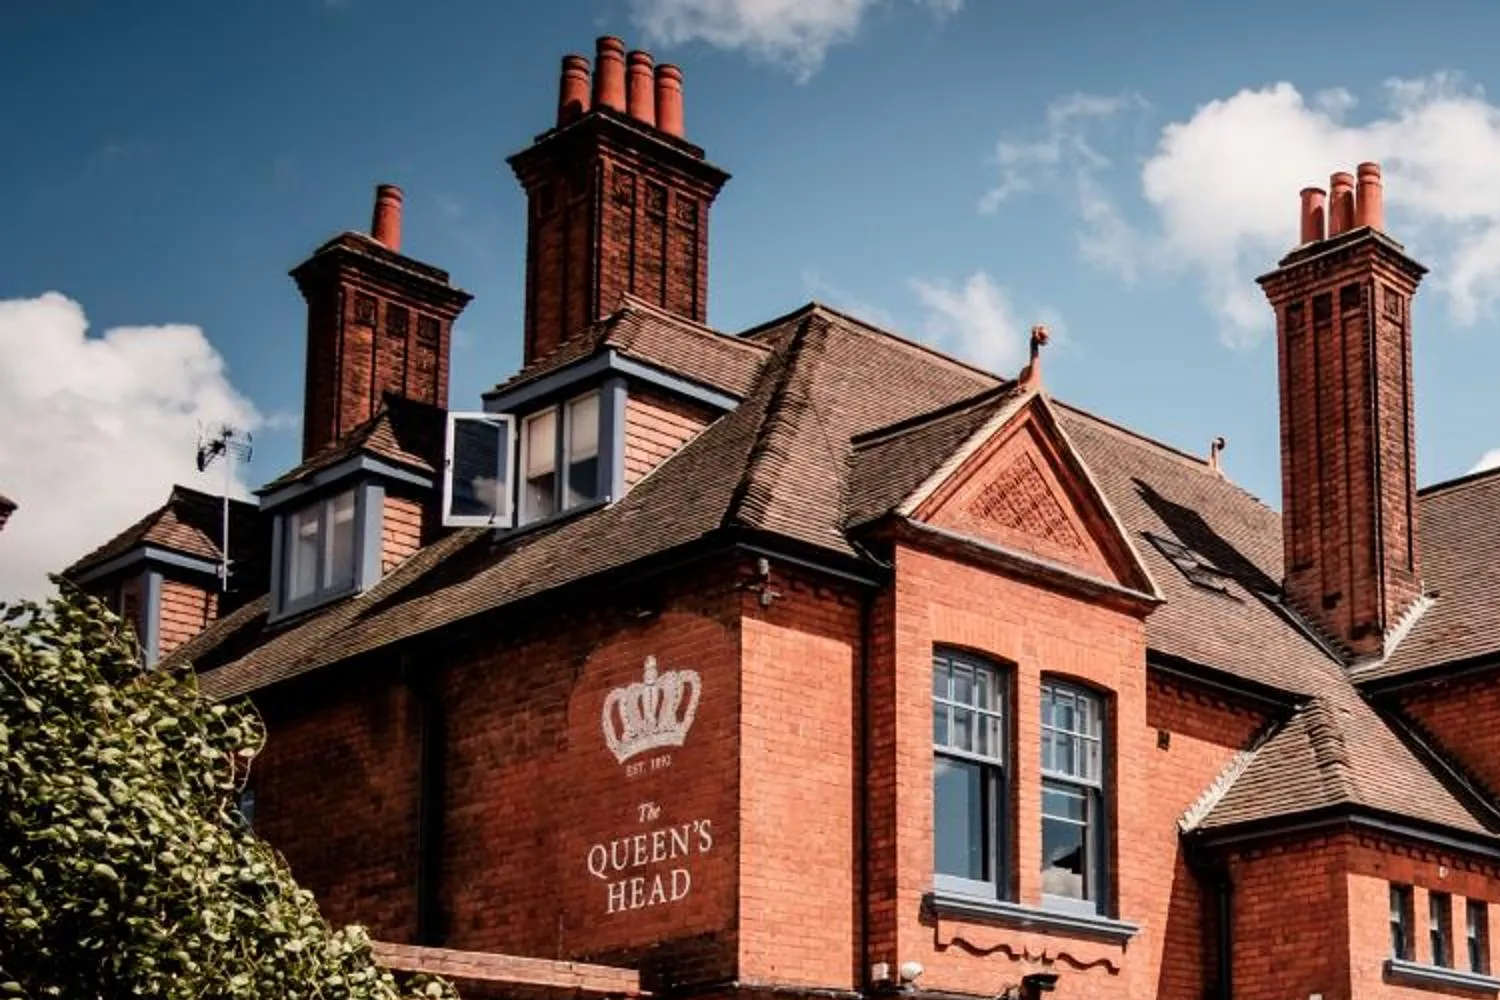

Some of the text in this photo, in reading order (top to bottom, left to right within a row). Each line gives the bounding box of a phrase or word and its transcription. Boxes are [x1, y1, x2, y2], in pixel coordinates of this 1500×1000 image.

[638, 802, 661, 823] The
[587, 819, 713, 879] QUEEN'S
[606, 868, 691, 914] HEAD
